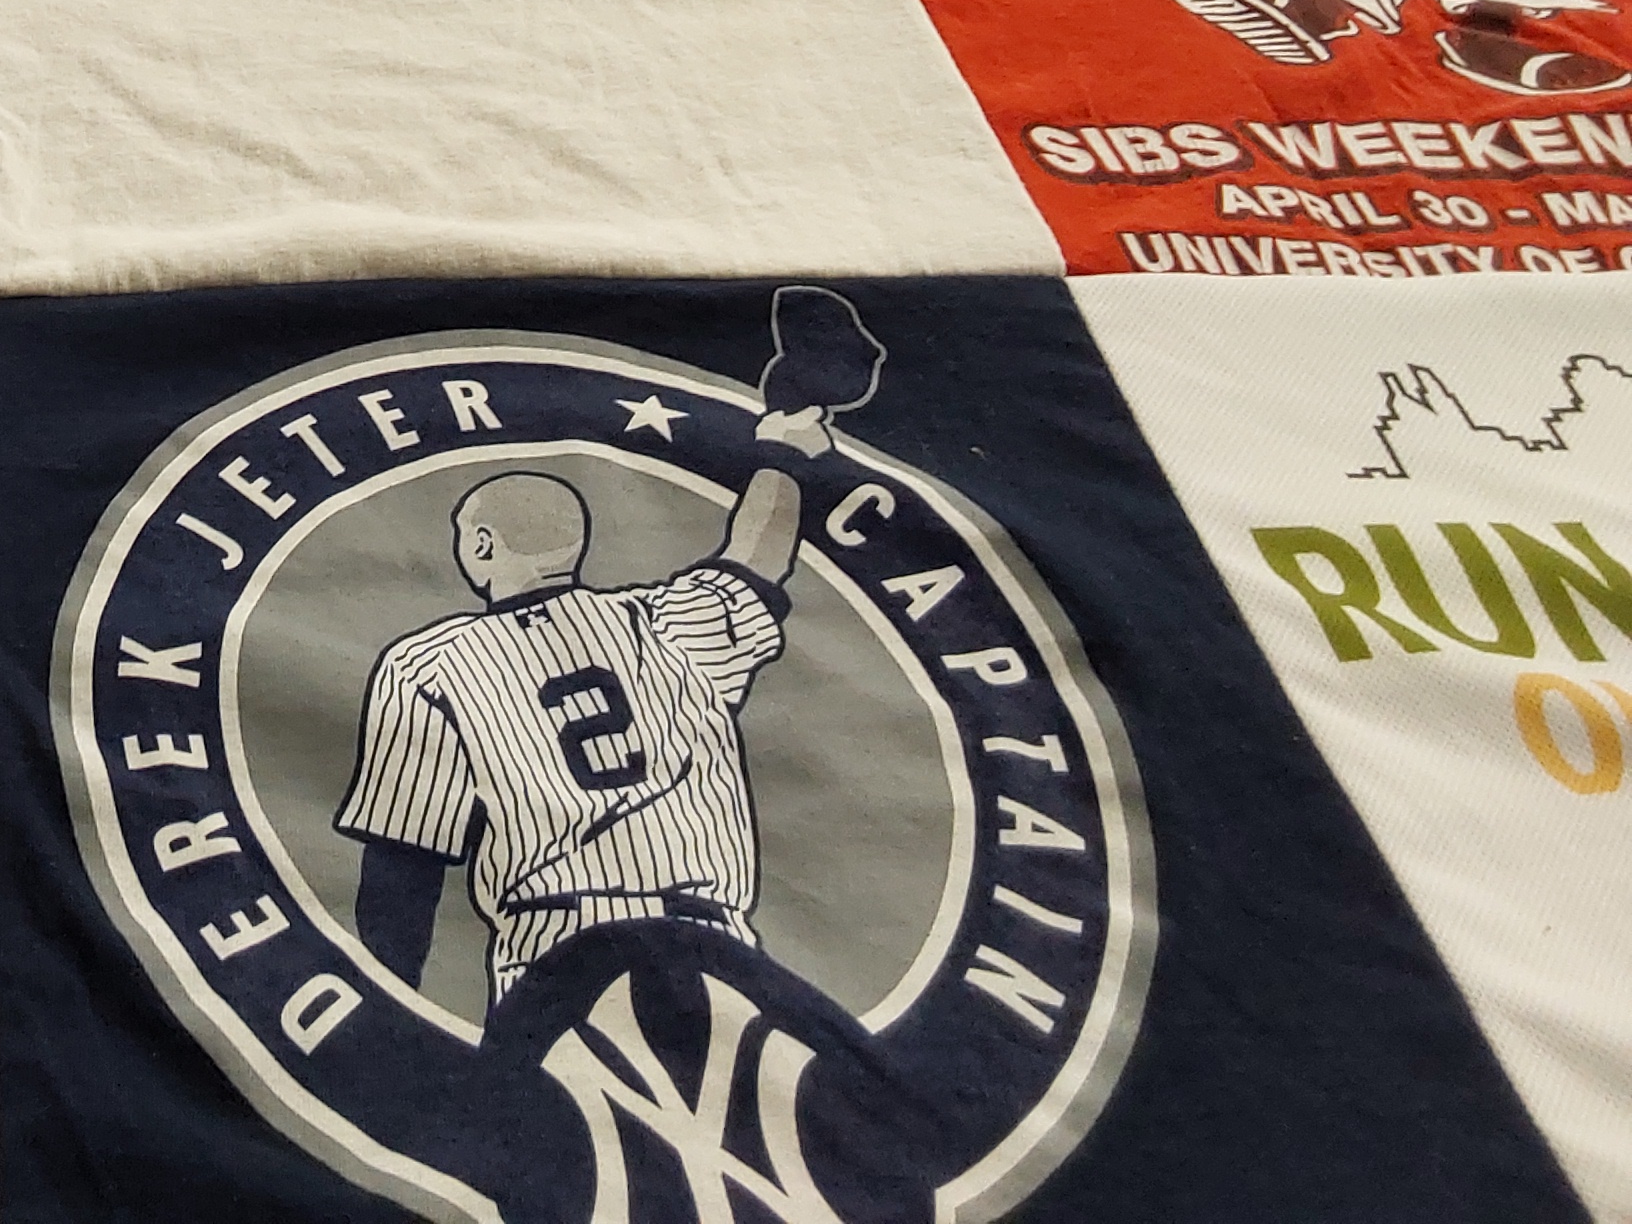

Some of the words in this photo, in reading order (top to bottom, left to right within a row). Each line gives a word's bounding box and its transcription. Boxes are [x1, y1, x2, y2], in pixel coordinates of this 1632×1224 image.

[1028, 121, 1241, 175] SIBS
[1218, 182, 1402, 230] APRIL
[1416, 189, 1489, 227] 30
[1120, 232, 1493, 277] UNIVERSITY
[1518, 243, 1602, 272] OF
[175, 378, 503, 572] JETER
[545, 666, 650, 790] 2
[823, 483, 1089, 1034] CAPTAIN
[118, 634, 362, 1057] DEREK
